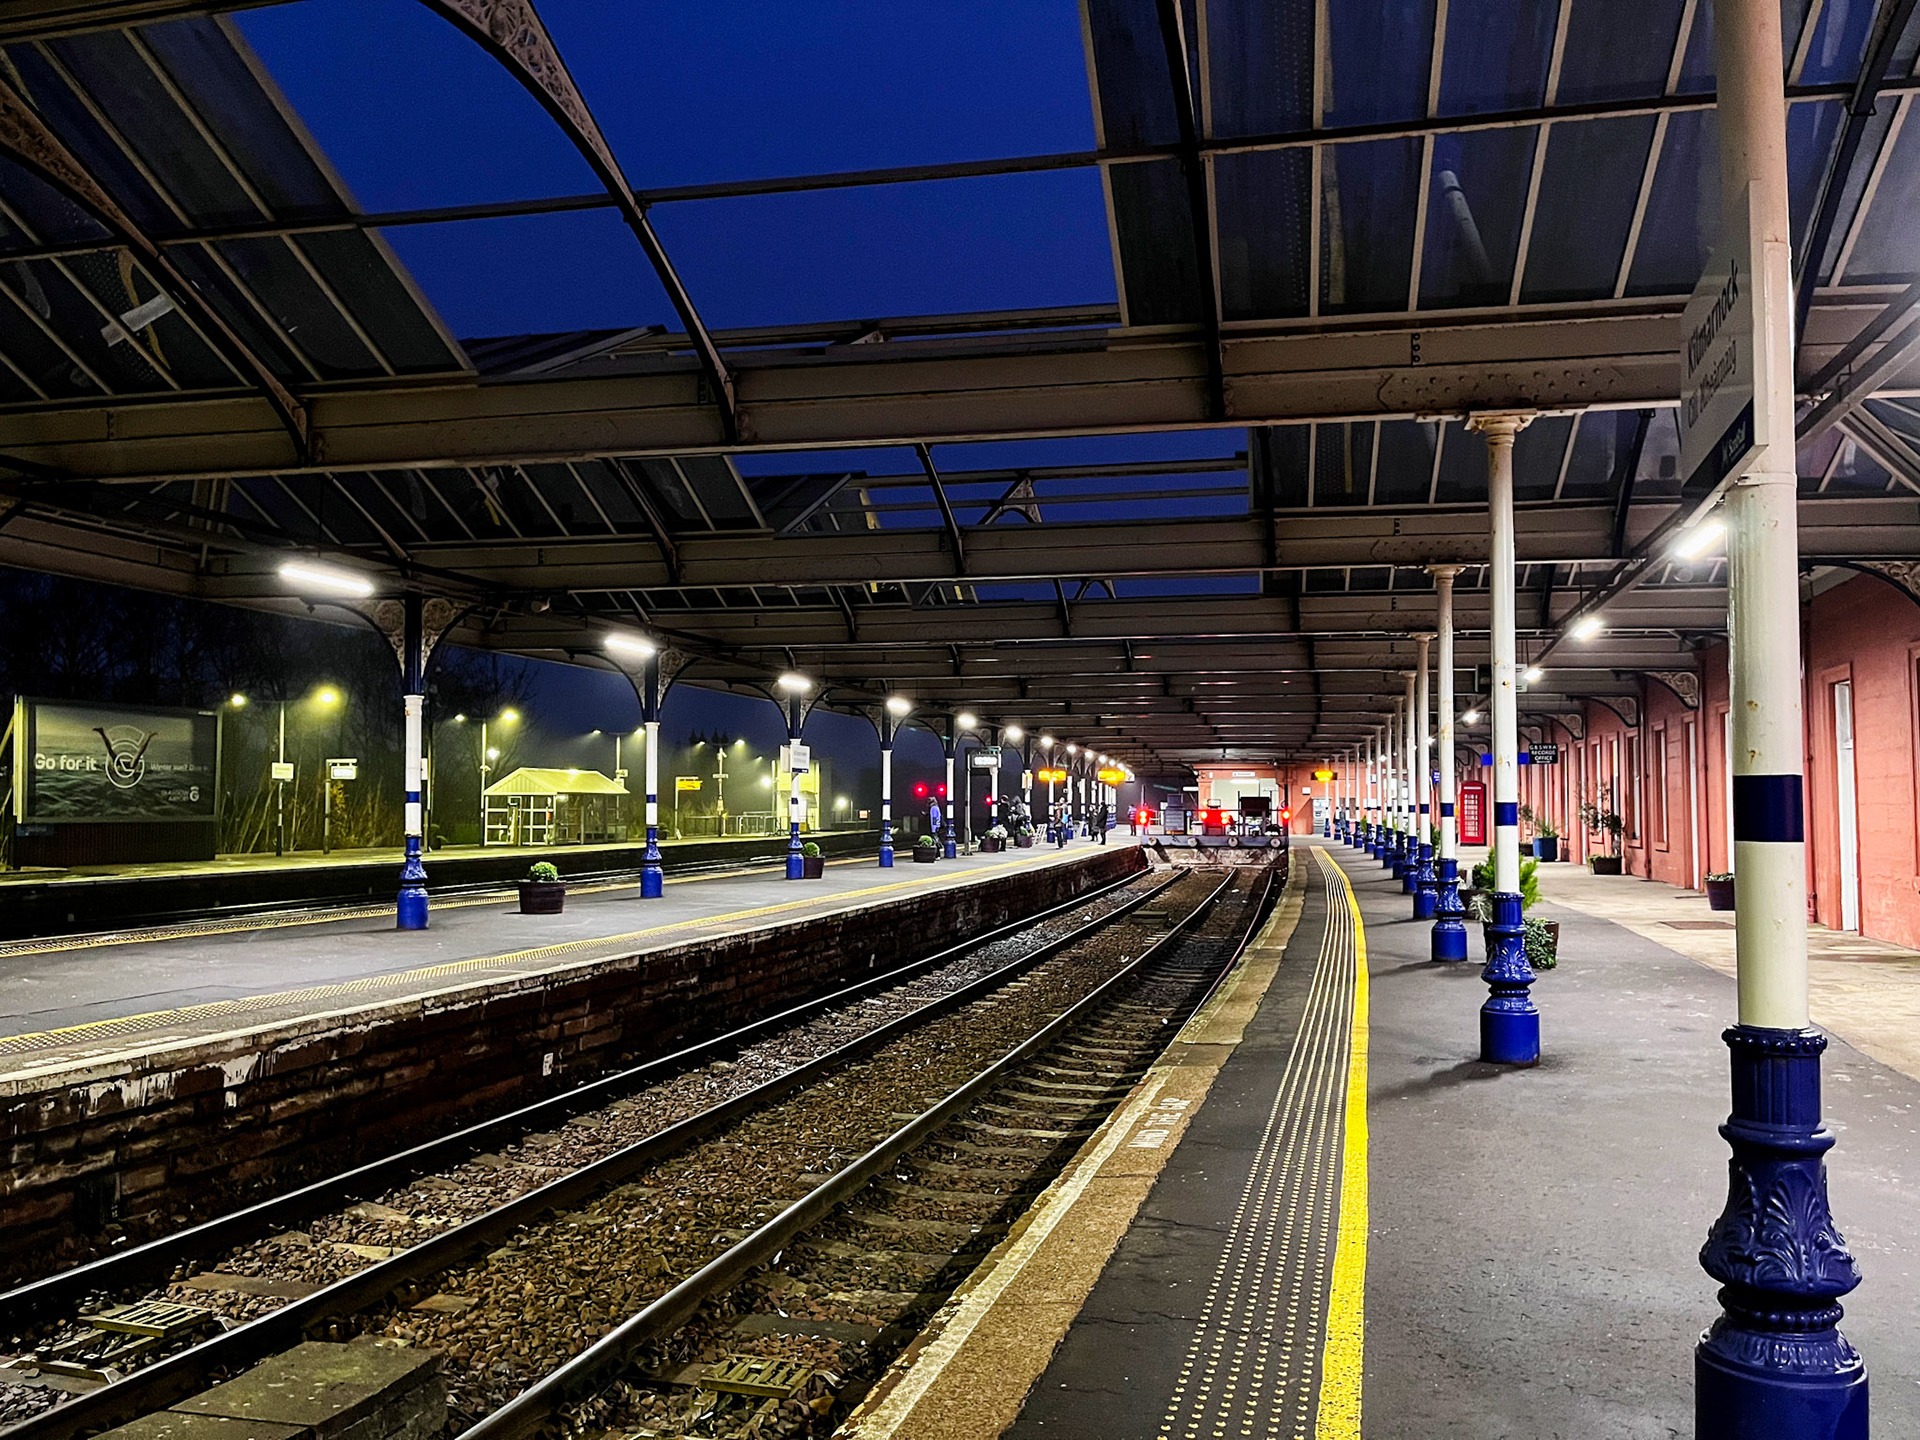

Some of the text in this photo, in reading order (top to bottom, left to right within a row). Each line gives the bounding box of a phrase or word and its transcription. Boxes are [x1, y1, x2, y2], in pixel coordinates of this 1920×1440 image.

[1688, 259, 1738, 379] Kilmarnock
[35, 753, 97, 771] Go for it
[1144, 1112, 1182, 1126] THE
